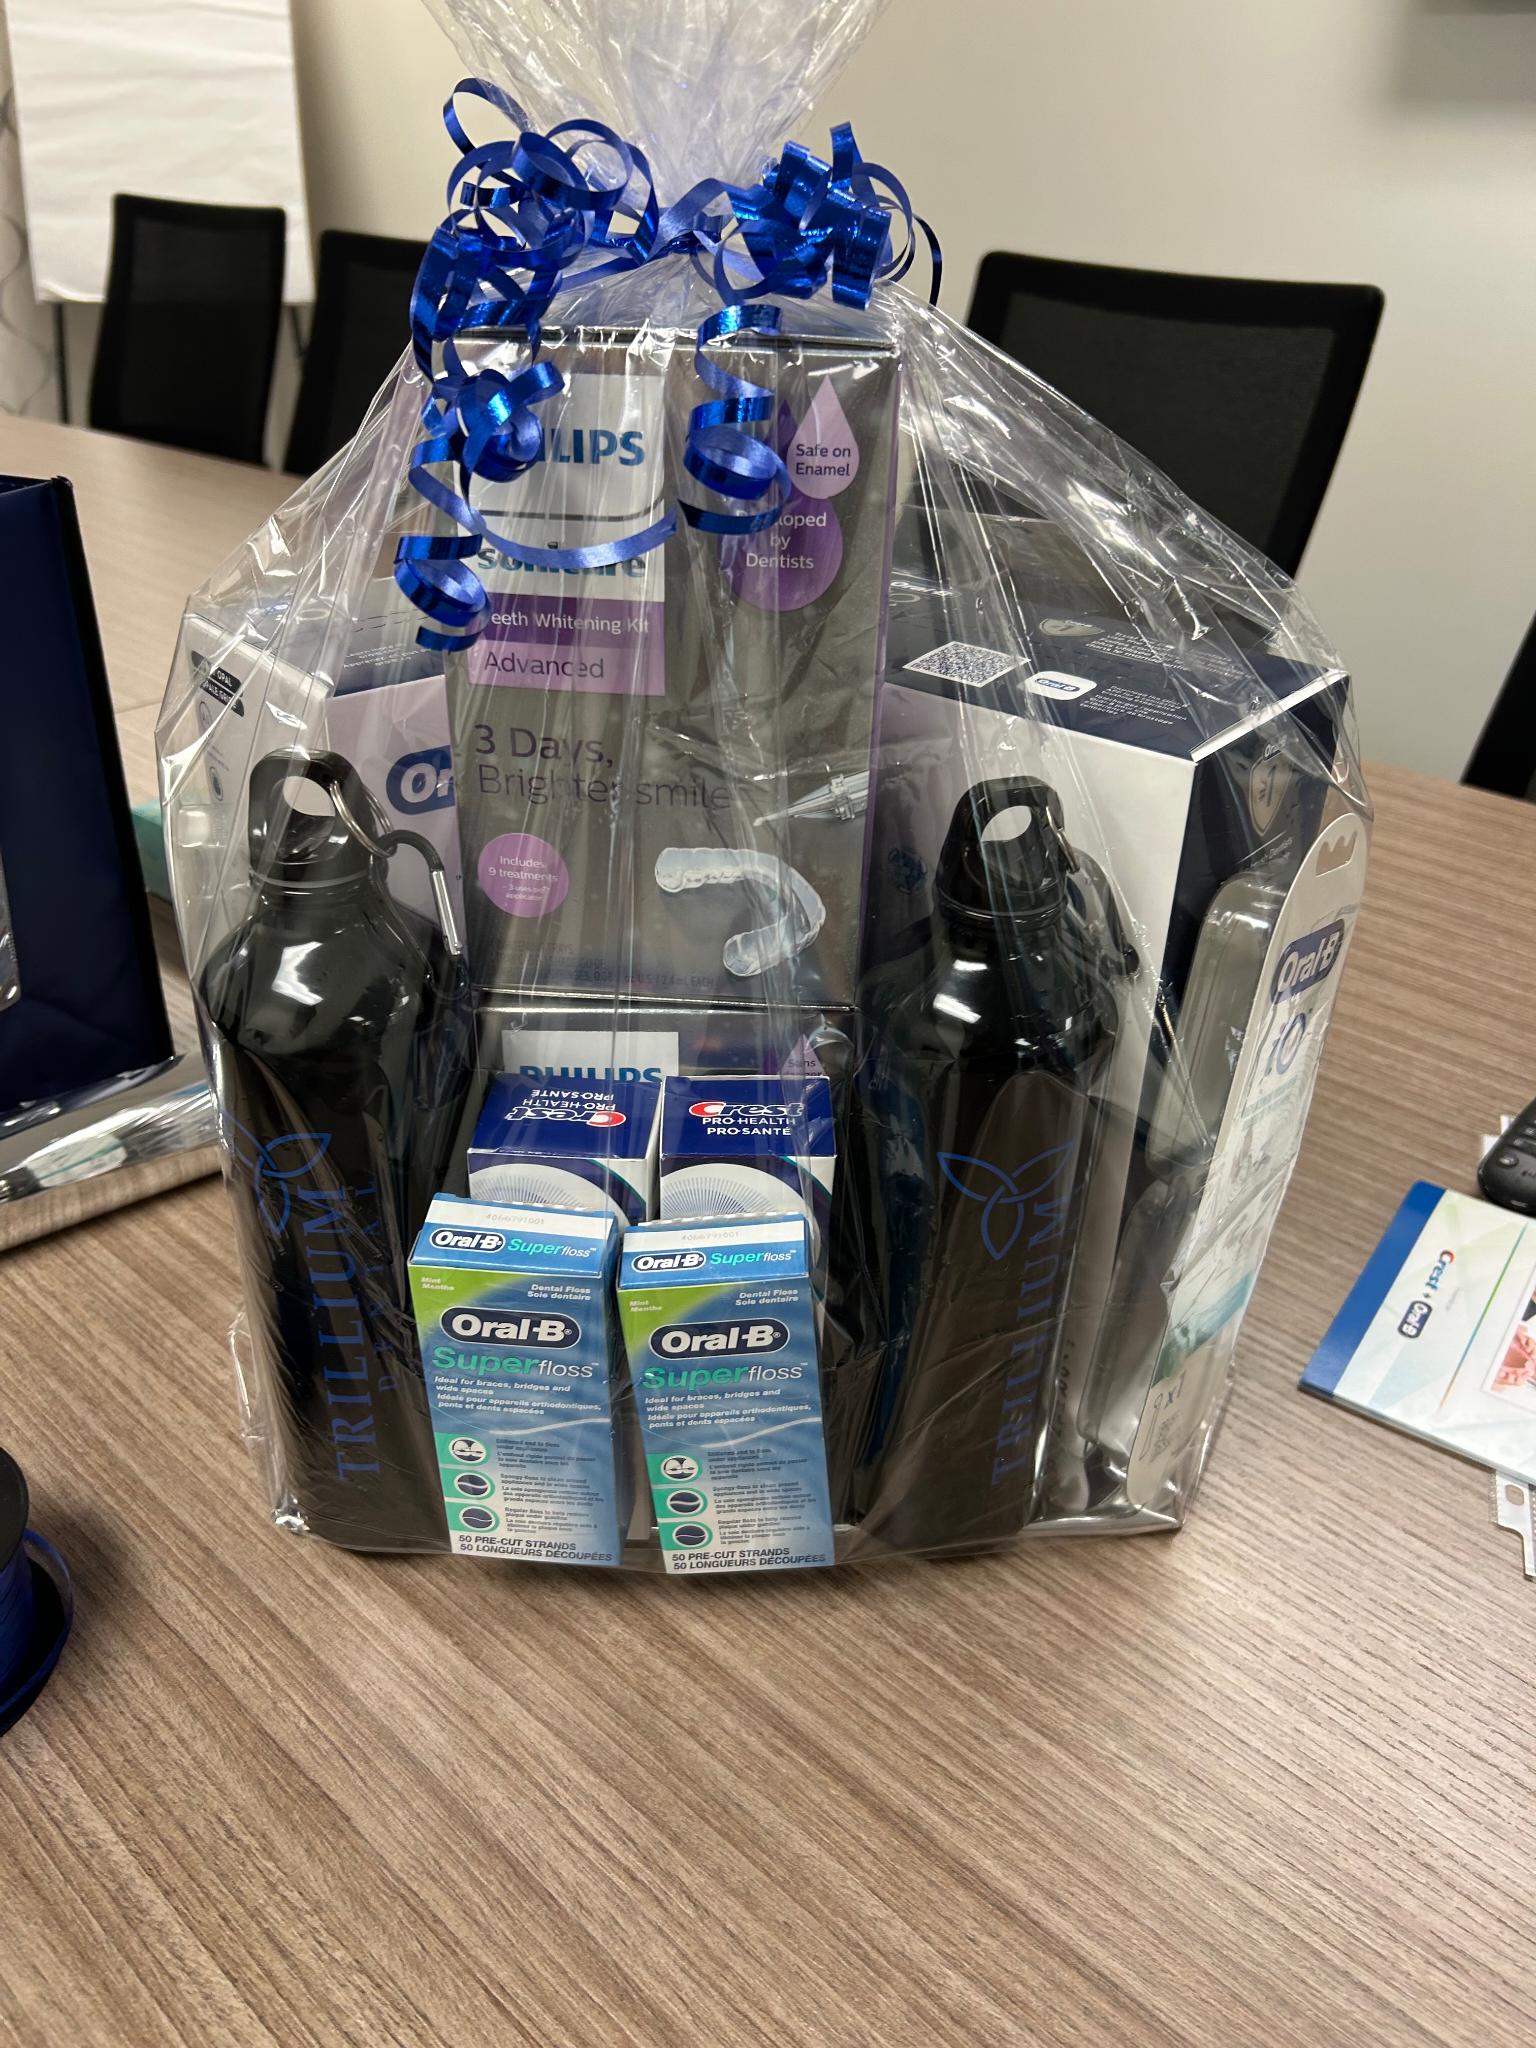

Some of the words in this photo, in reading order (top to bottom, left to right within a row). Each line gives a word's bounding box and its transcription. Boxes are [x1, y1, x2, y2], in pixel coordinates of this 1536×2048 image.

[541, 428, 645, 466] LIPS
[796, 444, 829, 458] Safe
[832, 447, 850, 458] on
[795, 462, 850, 476] Enamel
[770, 533, 791, 550] by
[746, 552, 814, 569] Dentists
[491, 611, 528, 627] eeth
[536, 613, 622, 635] Whitening
[627, 617, 649, 633] Kit
[484, 651, 604, 678] Advanced
[474, 724, 496, 754] 3
[509, 727, 613, 768] Days,
[478, 764, 620, 805] Brighter
[636, 780, 732, 809] smile
[500, 855, 546, 869] Includes
[488, 866, 496, 876] 9
[499, 868, 560, 881] treatments
[504, 1105, 627, 1128] Crest
[688, 1101, 805, 1117] Crest
[1425, 1250, 1455, 1289] Crest
[527, 1291, 549, 1299] Soie
[551, 1292, 591, 1301] dentaire
[531, 1284, 563, 1293] Dental
[566, 1286, 591, 1294] Floss
[739, 1290, 771, 1299] Dental
[735, 1298, 757, 1306] Soie
[758, 1295, 799, 1305] dentaire
[297, 1184, 380, 1481] TRILLIUM
[434, 1376, 459, 1385] Ideal
[460, 1377, 474, 1386] for
[477, 1379, 511, 1389] braces,
[514, 1382, 550, 1392] bridges
[553, 1384, 570, 1392] and
[436, 1385, 459, 1393] wide
[461, 1387, 494, 1396] spaces
[466, 1395, 486, 1404] pour
[489, 1398, 530, 1407] appareils
[531, 1400, 602, 1411] orthodontiques,
[645, 1396, 669, 1404] Ideal
[671, 1395, 685, 1403] for
[687, 1393, 722, 1402] braces,
[724, 1391, 760, 1400] bridges
[763, 1388, 781, 1396] and
[438, 1401, 463, 1411] ponts
[477, 1404, 501, 1412] dents
[646, 1404, 669, 1412] wide
[671, 1402, 705, 1411] spaces
[677, 1412, 698, 1421] pour
[700, 1409, 740, 1418] appareils
[742, 1404, 812, 1415] orthodontiques,
[649, 1421, 674, 1430] ponts
[676, 1419, 686, 1427] et
[688, 1418, 712, 1427] dents
[459, 1534, 472, 1543] 50
[475, 1536, 523, 1547] PRE-CUT
[525, 1539, 576, 1550] STRANDS
[460, 1543, 473, 1551] 50
[476, 1545, 543, 1557] LONGUEURS
[545, 1548, 612, 1561] DÉCOUPÉES
[672, 1554, 686, 1562] 50
[688, 1551, 736, 1561] PRE-CUT
[738, 1548, 790, 1558] STRANDS
[674, 1562, 687, 1570] 50
[690, 1559, 756, 1570] LONGUEURS
[759, 1554, 826, 1566] DÉCOUPÉES
